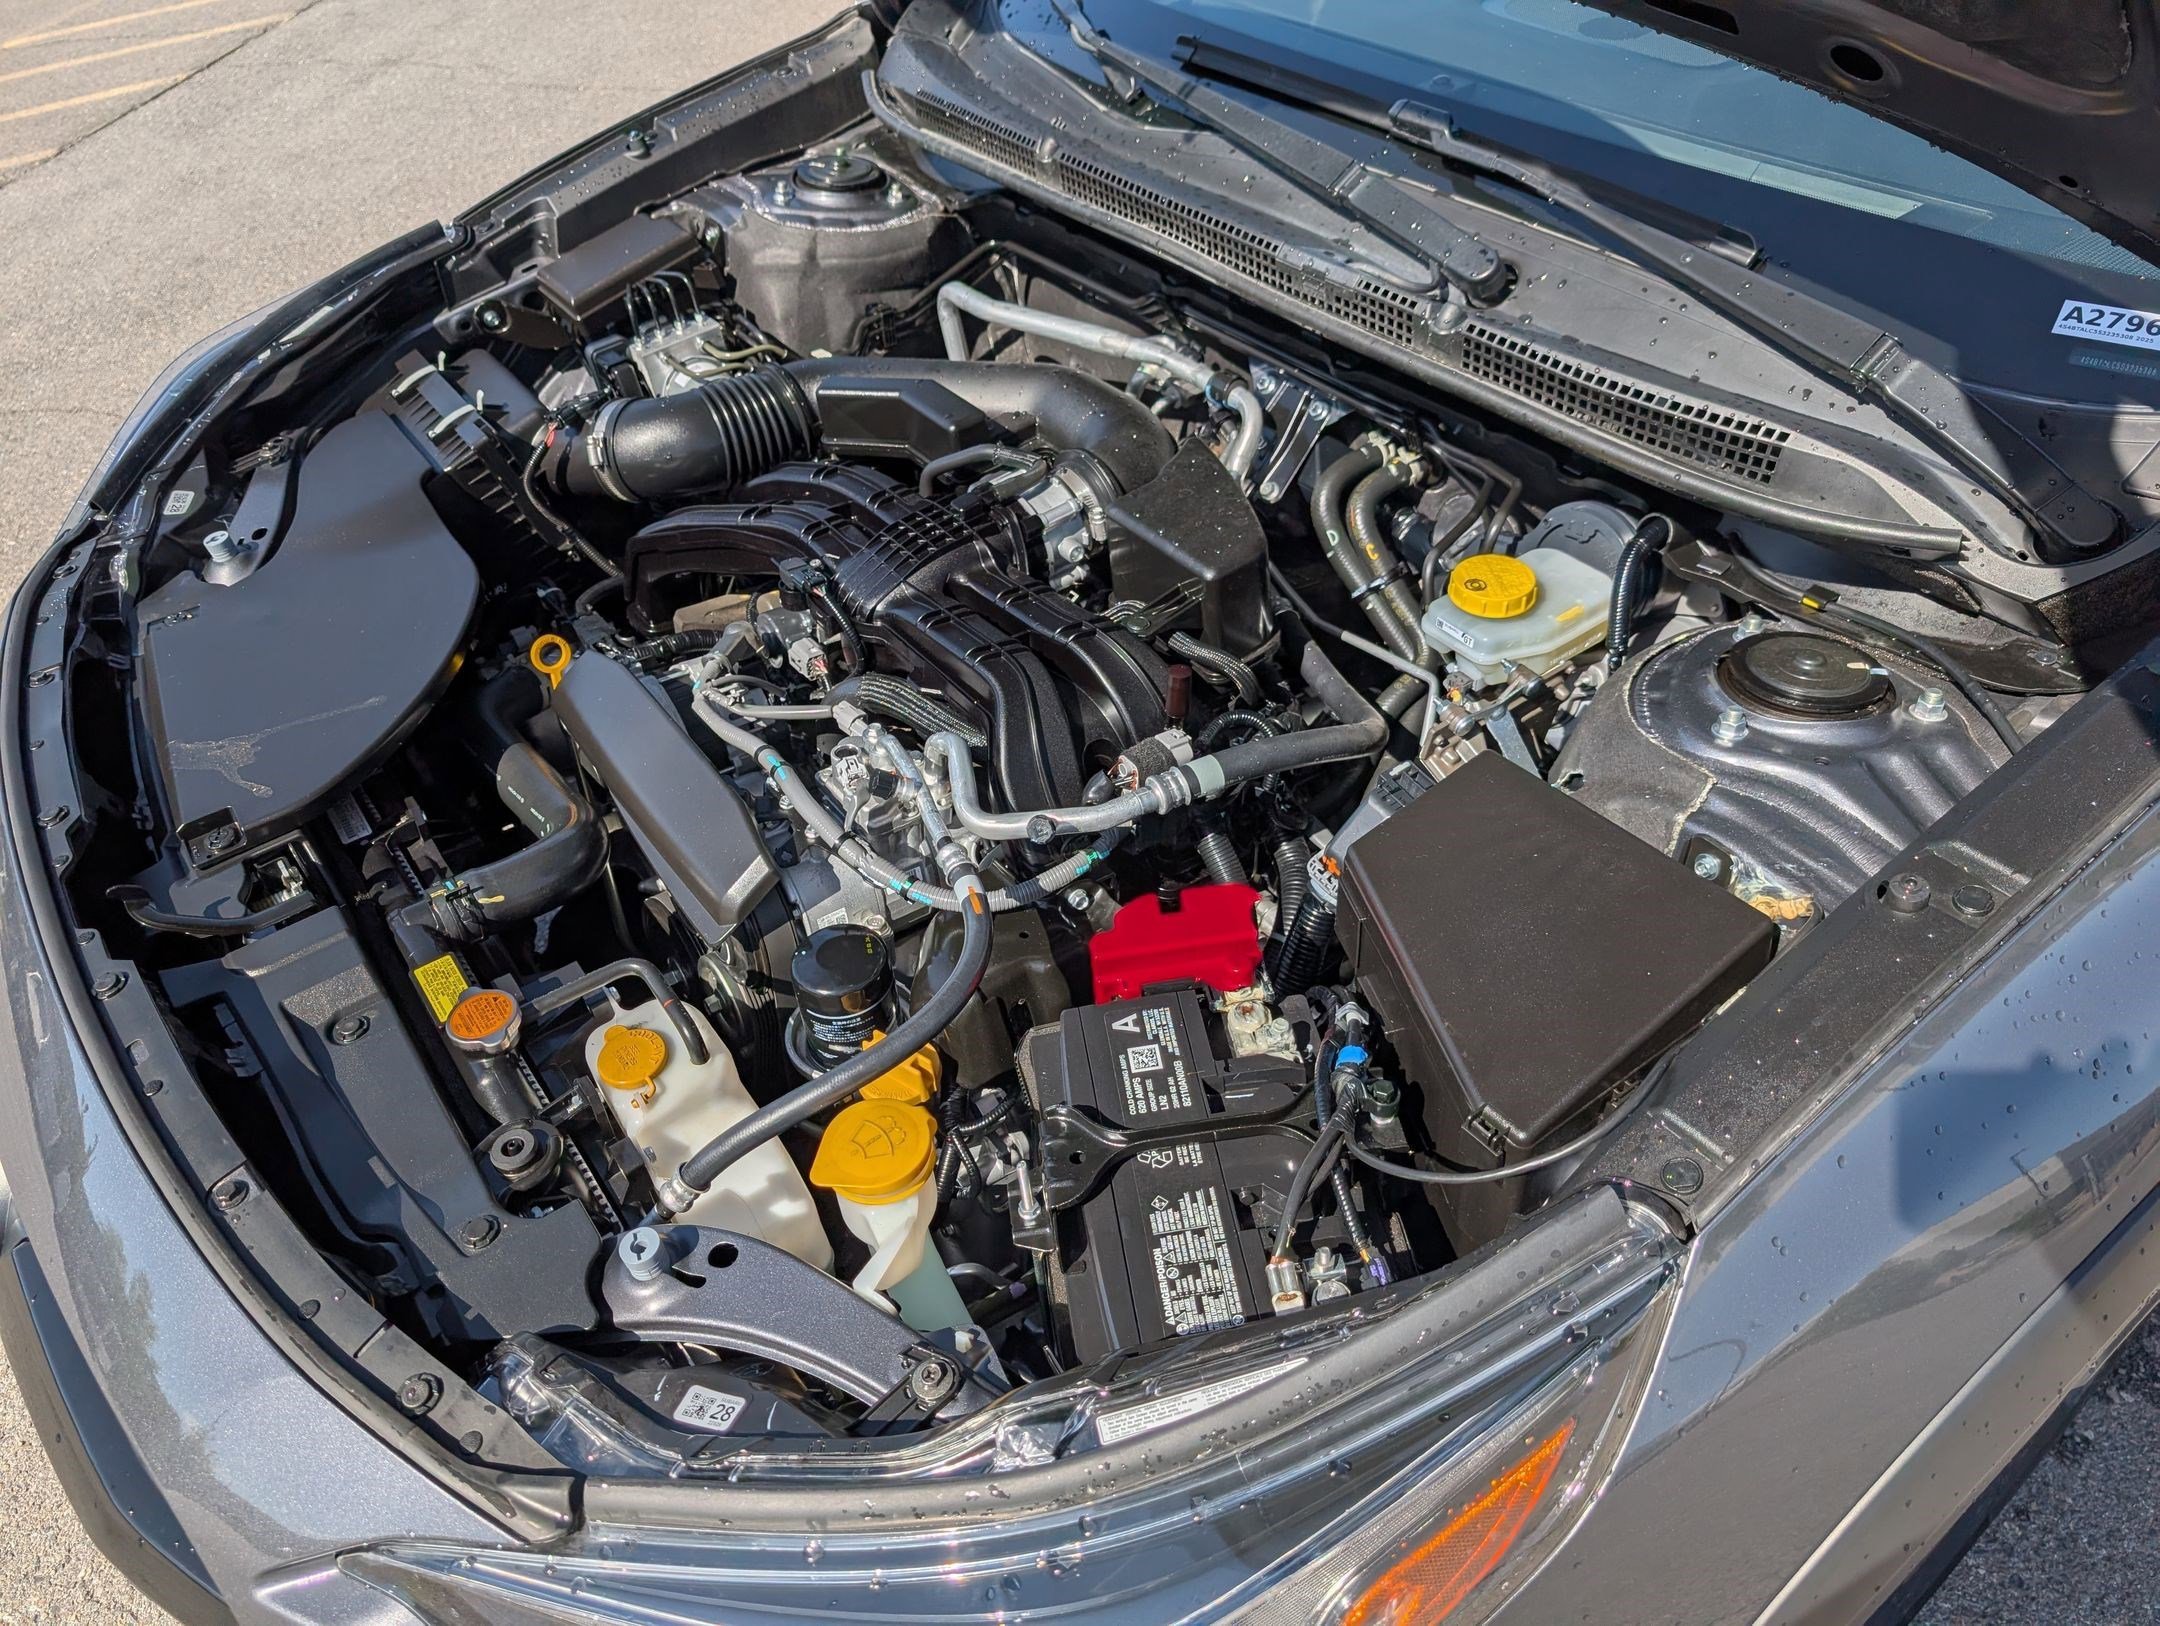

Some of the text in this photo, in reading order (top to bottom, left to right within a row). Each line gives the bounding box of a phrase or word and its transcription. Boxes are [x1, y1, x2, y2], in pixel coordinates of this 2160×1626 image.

[1112, 1013, 1140, 1032] A
[1119, 1054, 1136, 1115] COLD CRANKING AMPS
[1132, 1078, 1147, 1114] 620 AMPS
[1145, 1078, 1158, 1112] GROUP SIZE
[1174, 1060, 1192, 1106] 82110AN00B
[1159, 1095, 1169, 1110] LN2
[1152, 1248, 1174, 1317] DANGER/POISON
[709, 1404, 736, 1422] 28
